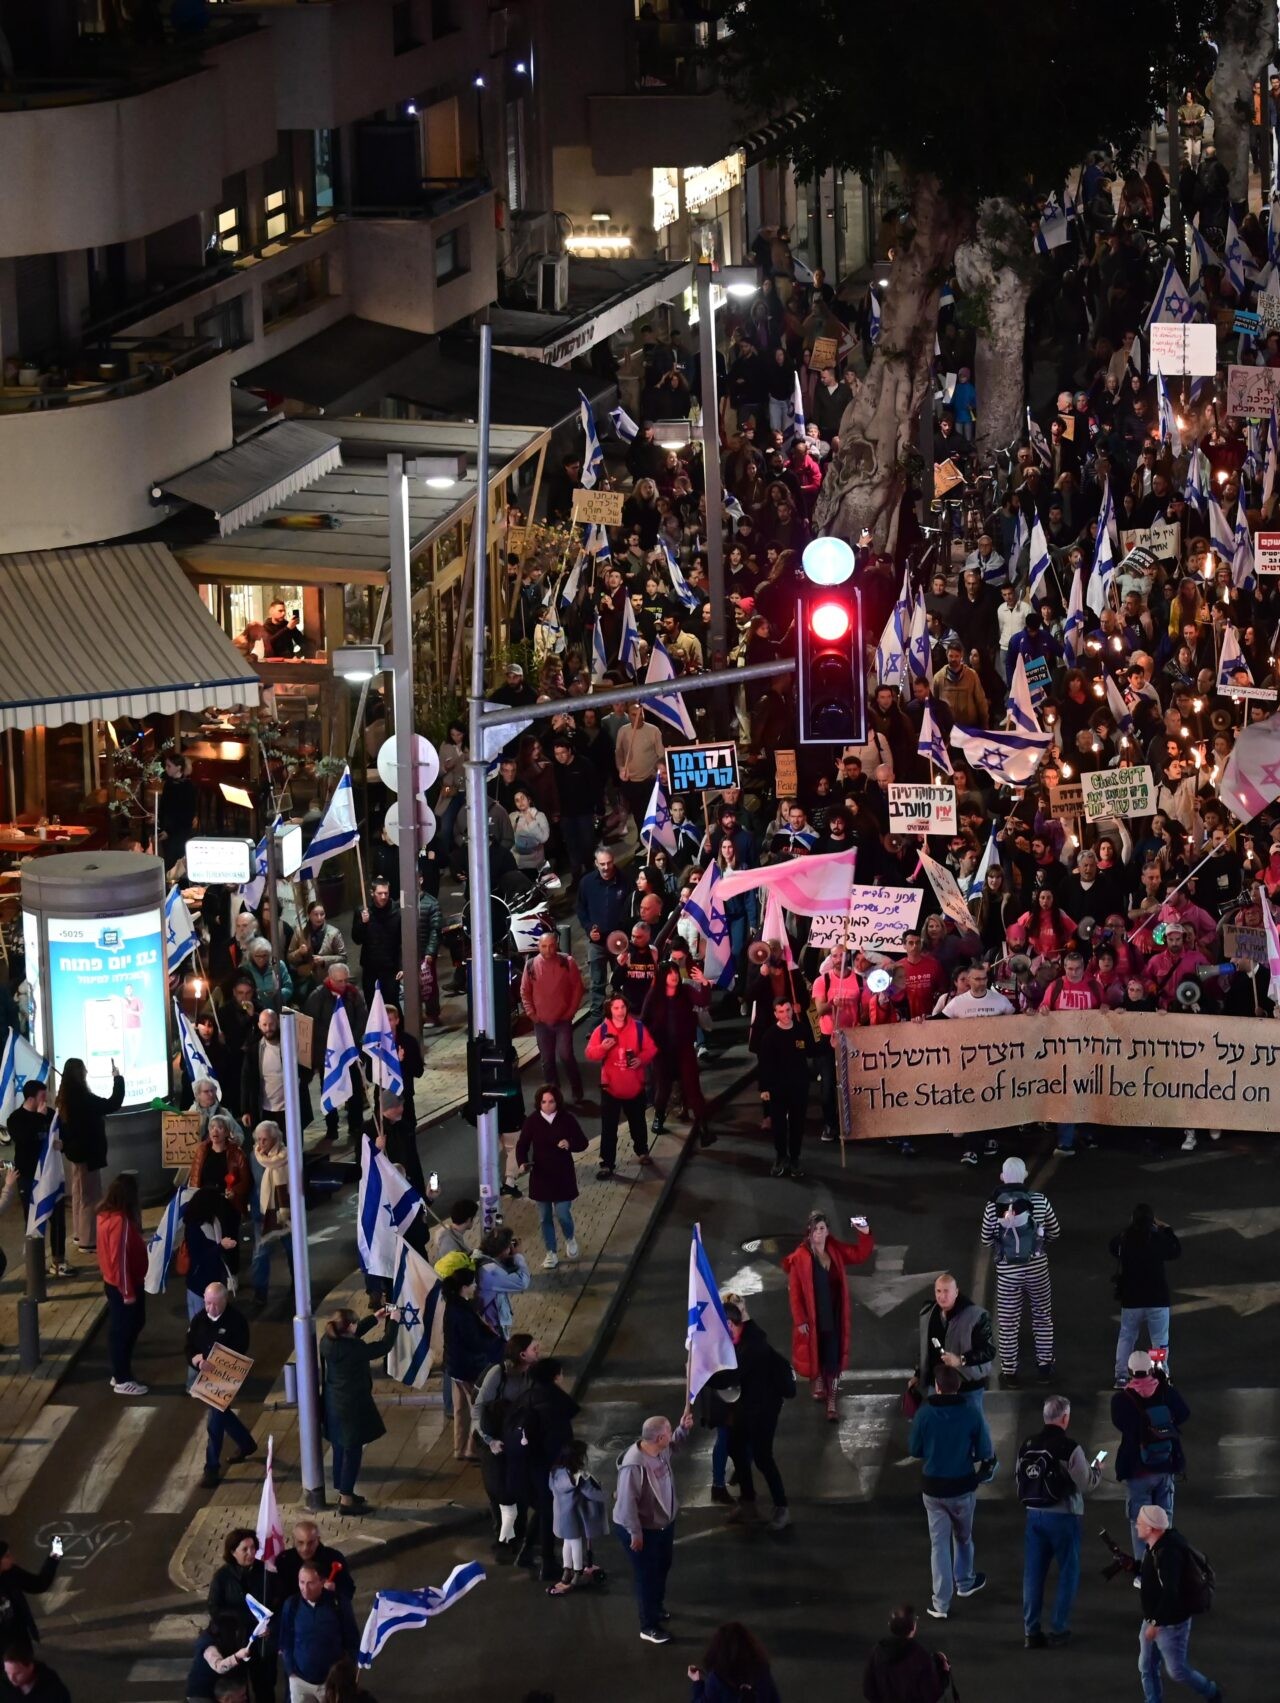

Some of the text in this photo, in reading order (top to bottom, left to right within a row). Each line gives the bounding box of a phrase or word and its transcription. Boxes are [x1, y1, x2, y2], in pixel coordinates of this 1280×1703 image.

[673, 767, 733, 790] קרטיה
[891, 786, 953, 802] לדמוקרטיה
[935, 805, 952, 820] אין
[59, 957, 103, 972] פתוח
[960, 1041, 1025, 1070] הצדק
[1034, 1036, 1122, 1061] החירות,
[1127, 1039, 1205, 1060] יסודות
[1213, 1031, 1245, 1065] על
[914, 1082, 976, 1106] State
[981, 1069, 1007, 1103] of
[1011, 1064, 1067, 1102] Israel
[1072, 1063, 1104, 1095] will
[1109, 1064, 1137, 1097] be
[1143, 1066, 1237, 1100] founded
[1242, 1085, 1270, 1103] on
[197, 1372, 233, 1402] Peace
